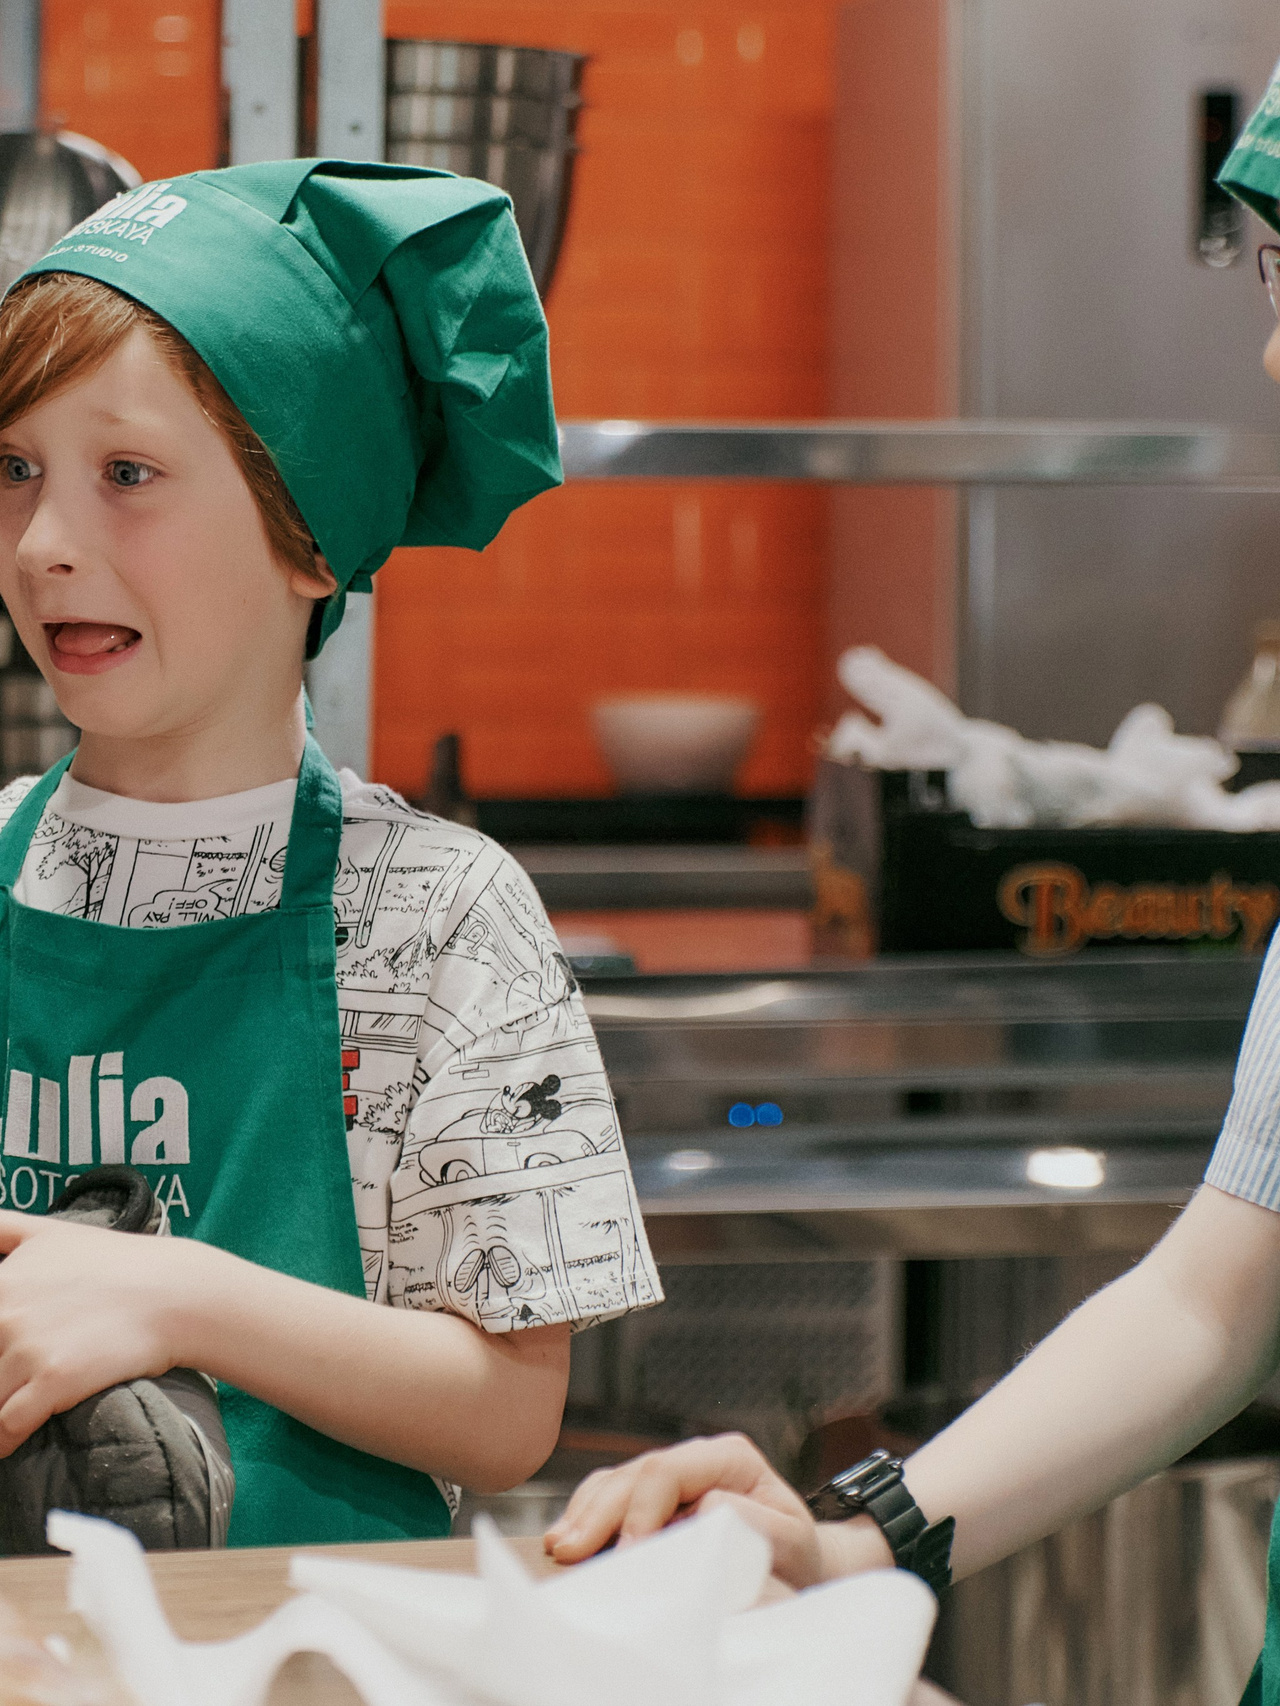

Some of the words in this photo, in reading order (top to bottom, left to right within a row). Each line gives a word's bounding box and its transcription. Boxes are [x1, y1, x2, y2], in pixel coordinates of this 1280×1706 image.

[73, 245, 128, 262] STUDIO
[168, 897, 208, 911] OFF!
[998, 861, 1279, 957] Beauty
[142, 911, 171, 924] PAY
